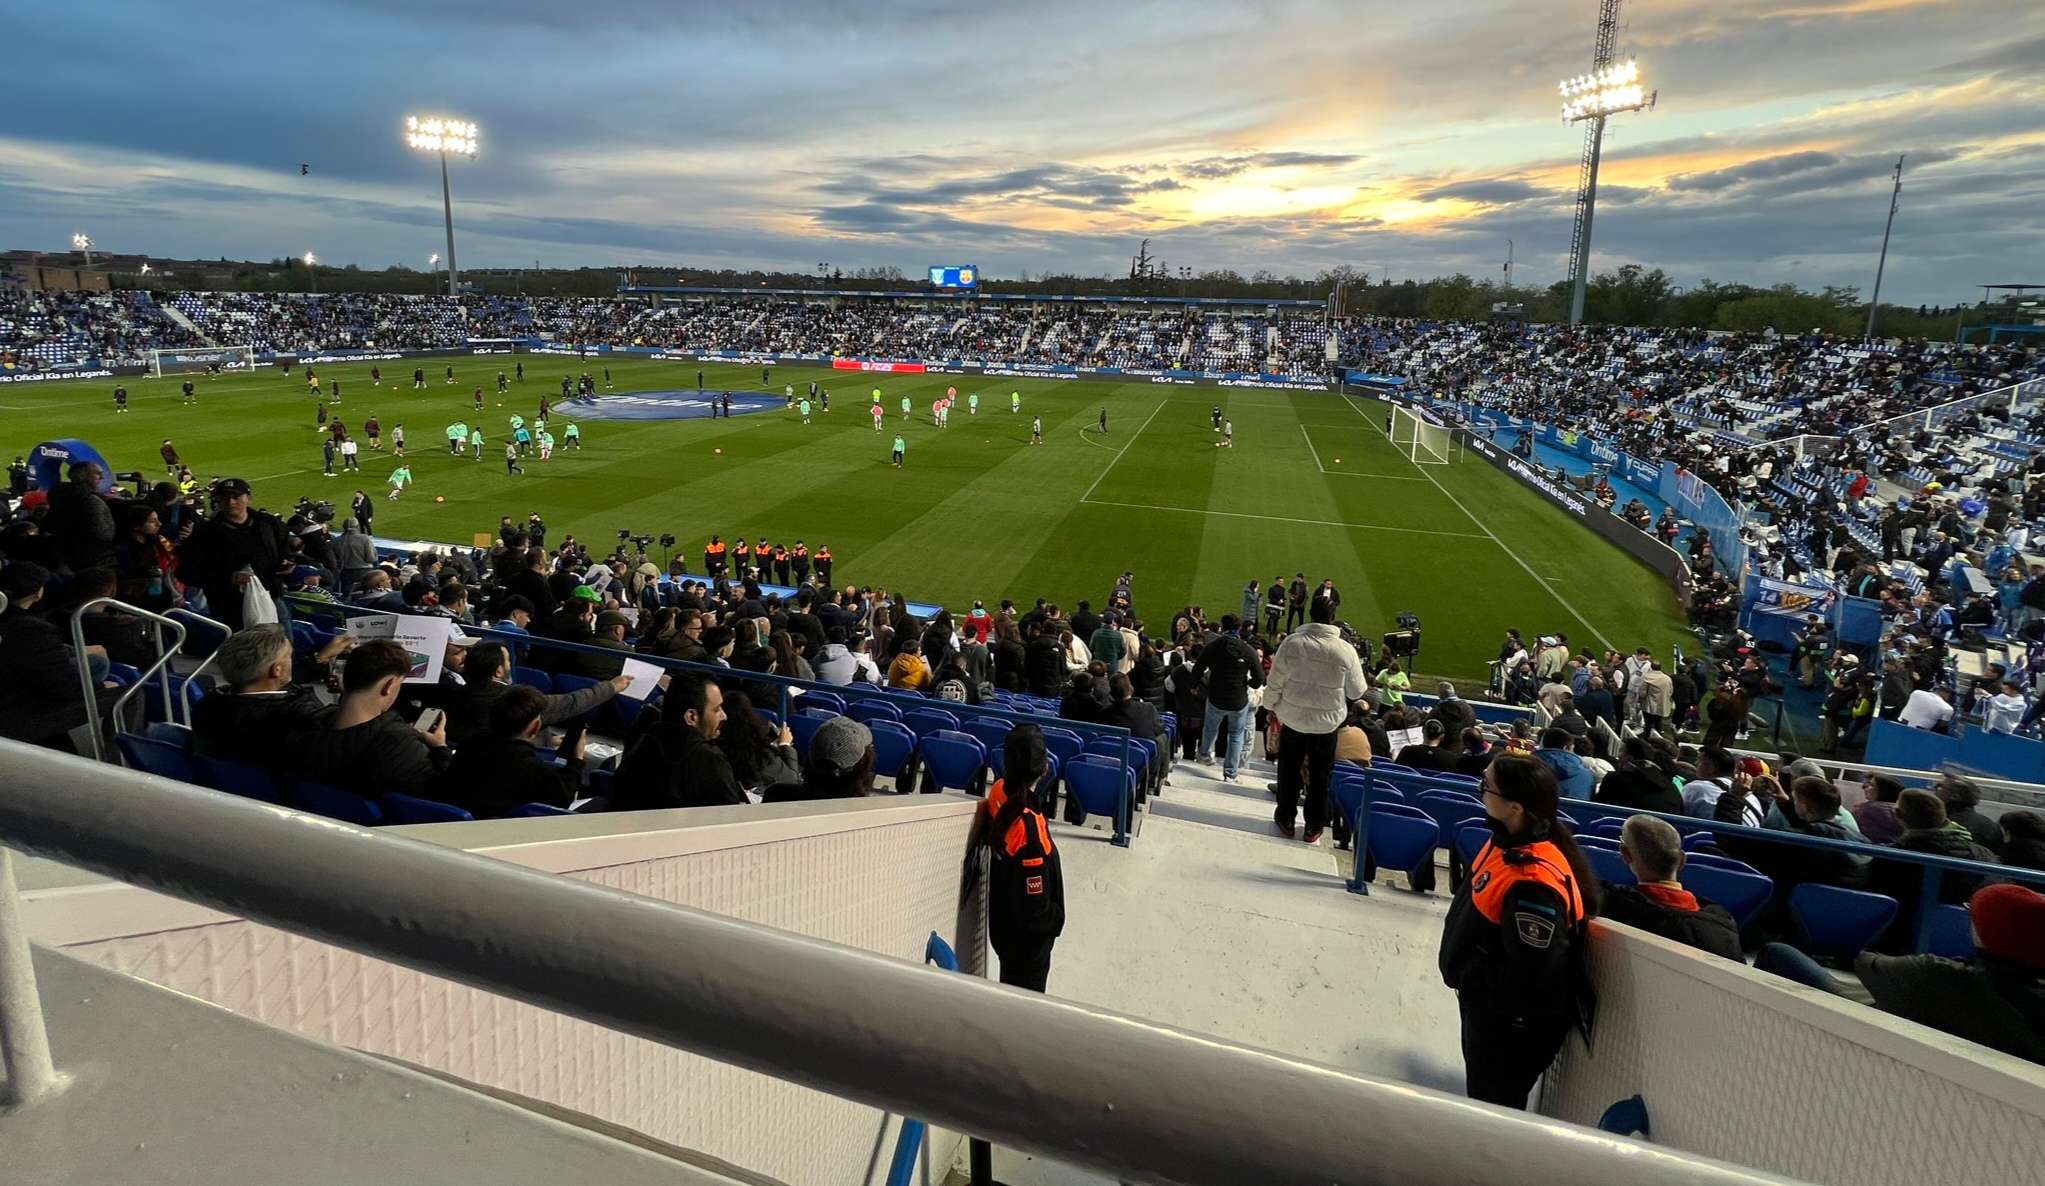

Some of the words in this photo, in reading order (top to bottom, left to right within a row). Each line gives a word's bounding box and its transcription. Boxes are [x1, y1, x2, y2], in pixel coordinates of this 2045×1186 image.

[14, 373, 45, 382] Oficial
[46, 372, 60, 380] Kia
[75, 369, 114, 379] Leganés.
